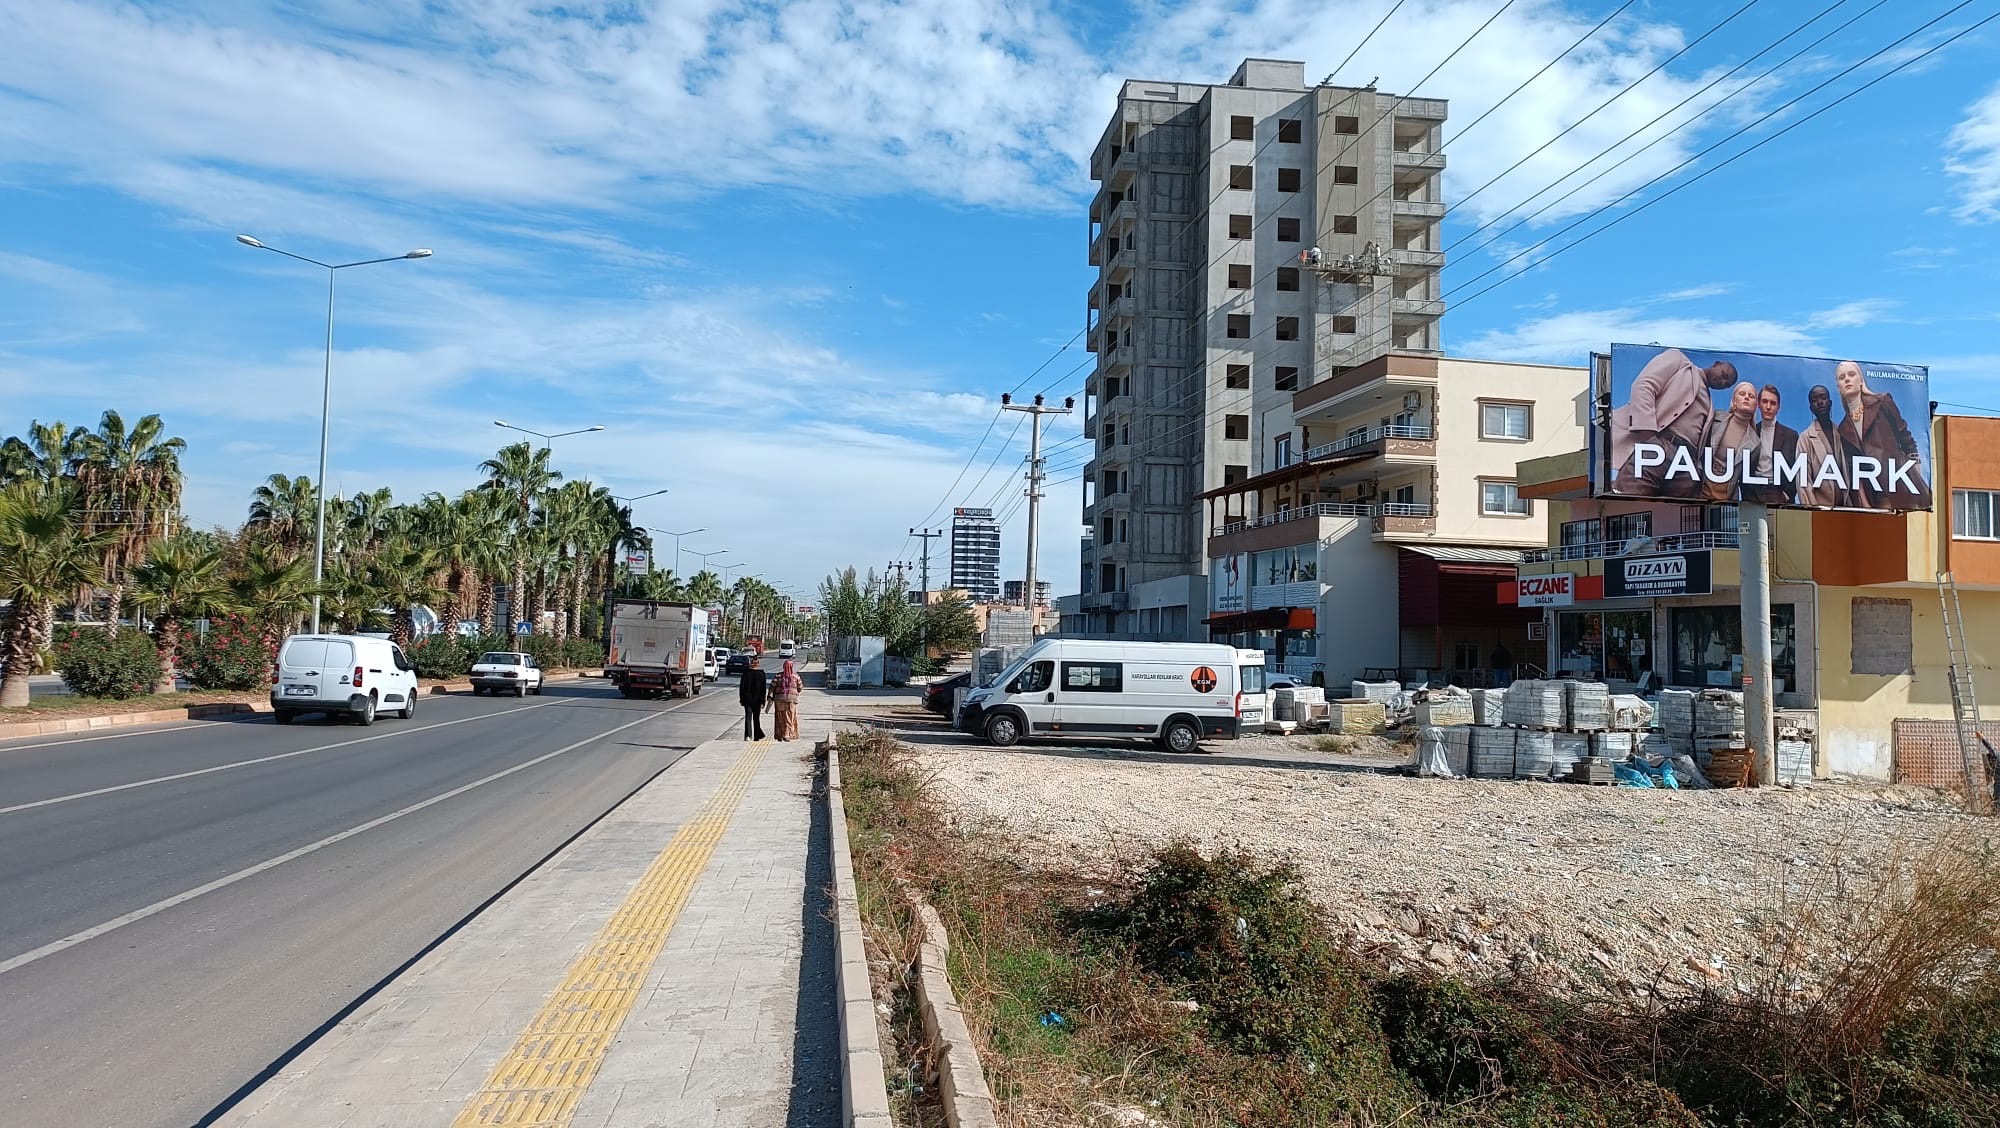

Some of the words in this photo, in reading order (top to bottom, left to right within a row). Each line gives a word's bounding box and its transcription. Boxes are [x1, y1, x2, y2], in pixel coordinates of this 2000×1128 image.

[1633, 442, 1921, 496] PAULMARK
[1519, 577, 1569, 596] ECZANE
[1534, 596, 1554, 604] SAĞLIK
